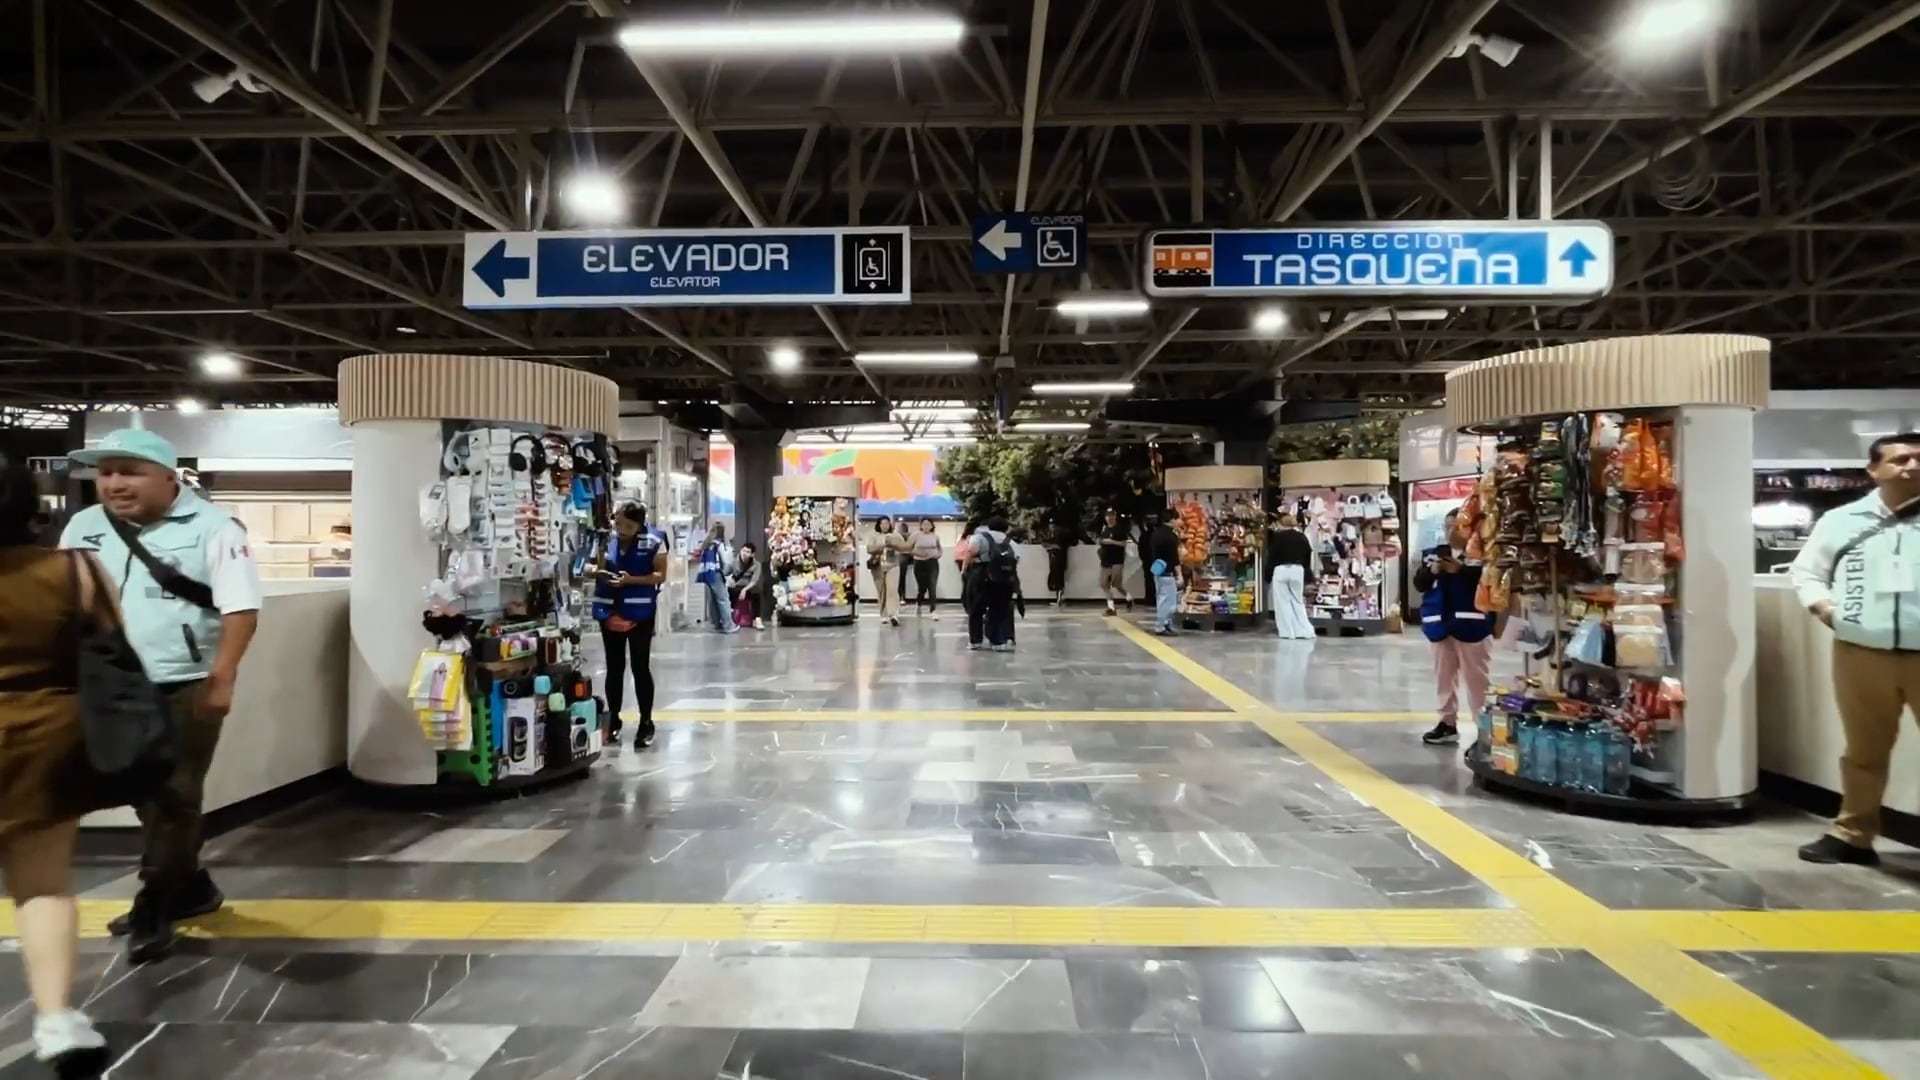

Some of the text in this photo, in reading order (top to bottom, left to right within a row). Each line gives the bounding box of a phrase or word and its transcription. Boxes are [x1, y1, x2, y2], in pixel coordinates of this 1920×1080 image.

[1030, 215, 1084, 225] ELEVADOR
[582, 243, 790, 273] ELEVADOR
[1242, 247, 1519, 286] TASQUEÑA
[649, 276, 721, 289] ELEVATOR
